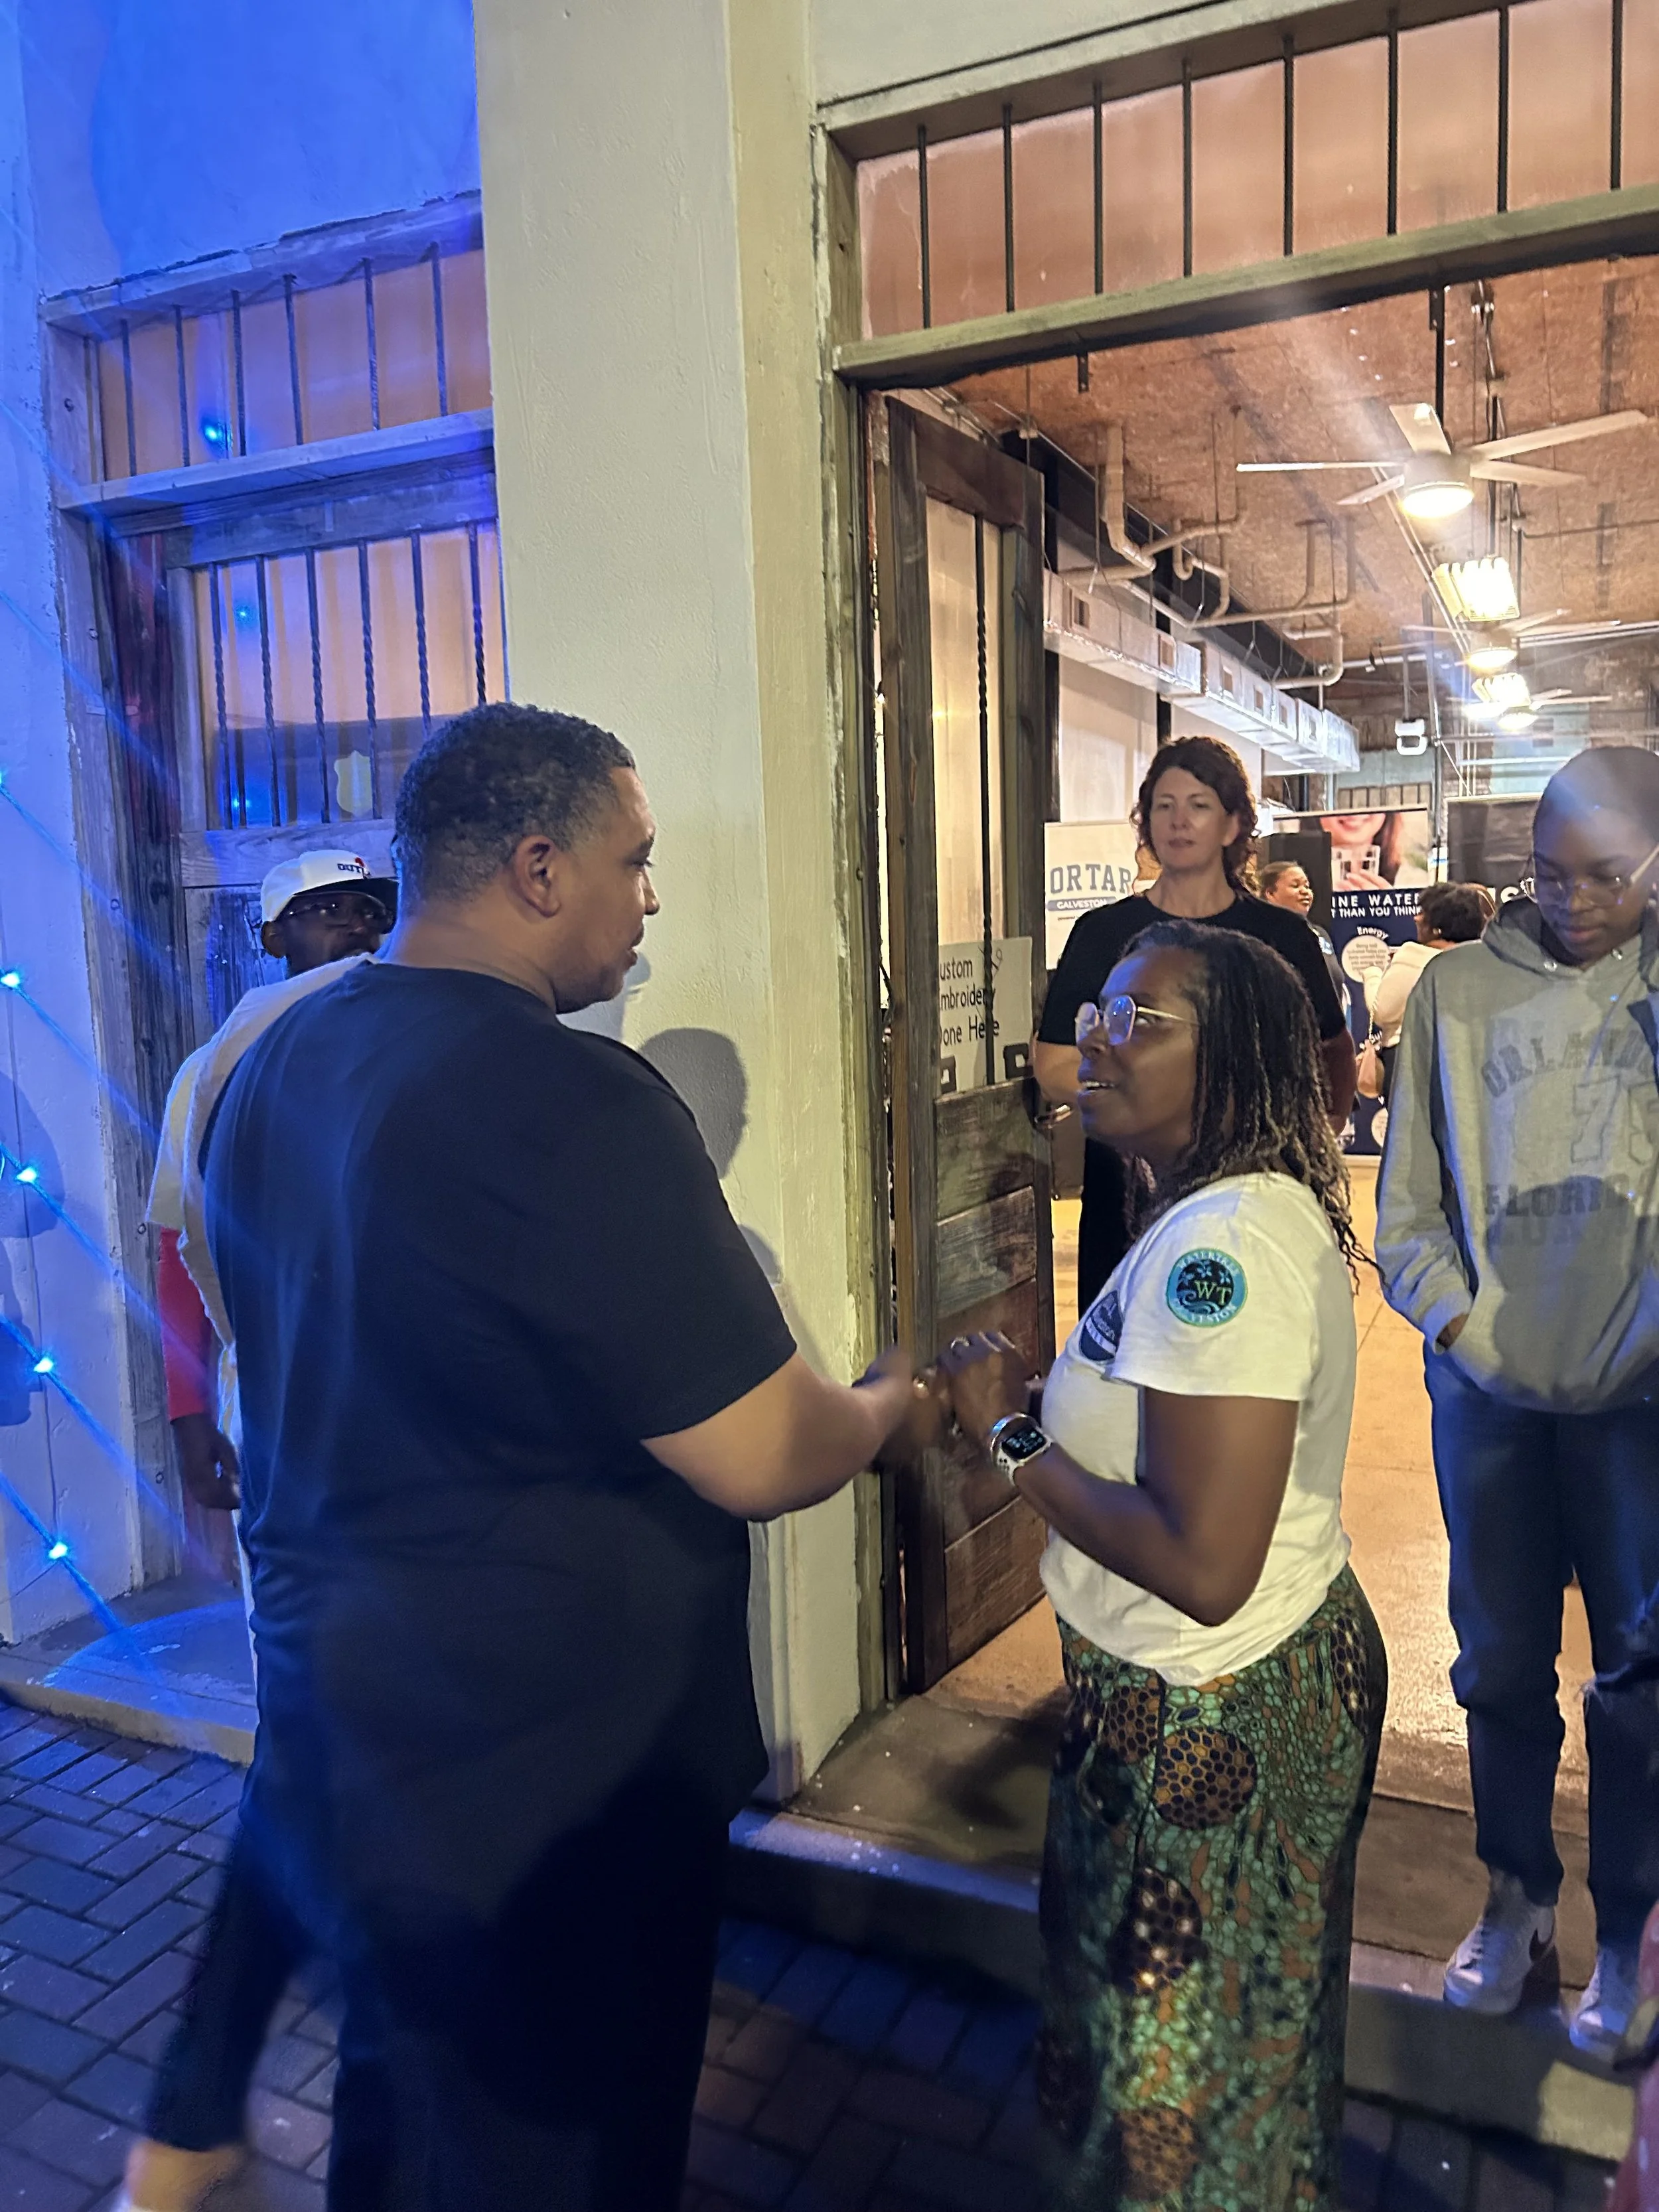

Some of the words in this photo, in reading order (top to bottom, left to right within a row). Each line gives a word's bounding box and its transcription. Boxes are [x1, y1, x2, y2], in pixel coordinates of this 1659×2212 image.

[1056, 899, 1108, 909] GALVESTON
[1339, 907, 1366, 919] THAN
[1369, 906, 1390, 917] YOU
[1356, 926, 1389, 940] Energy
[940, 1025, 962, 1047] one
[968, 1015, 999, 1042] Hee
[1484, 1177, 1646, 1217] FLORID
[1194, 1280, 1232, 1305] WT
